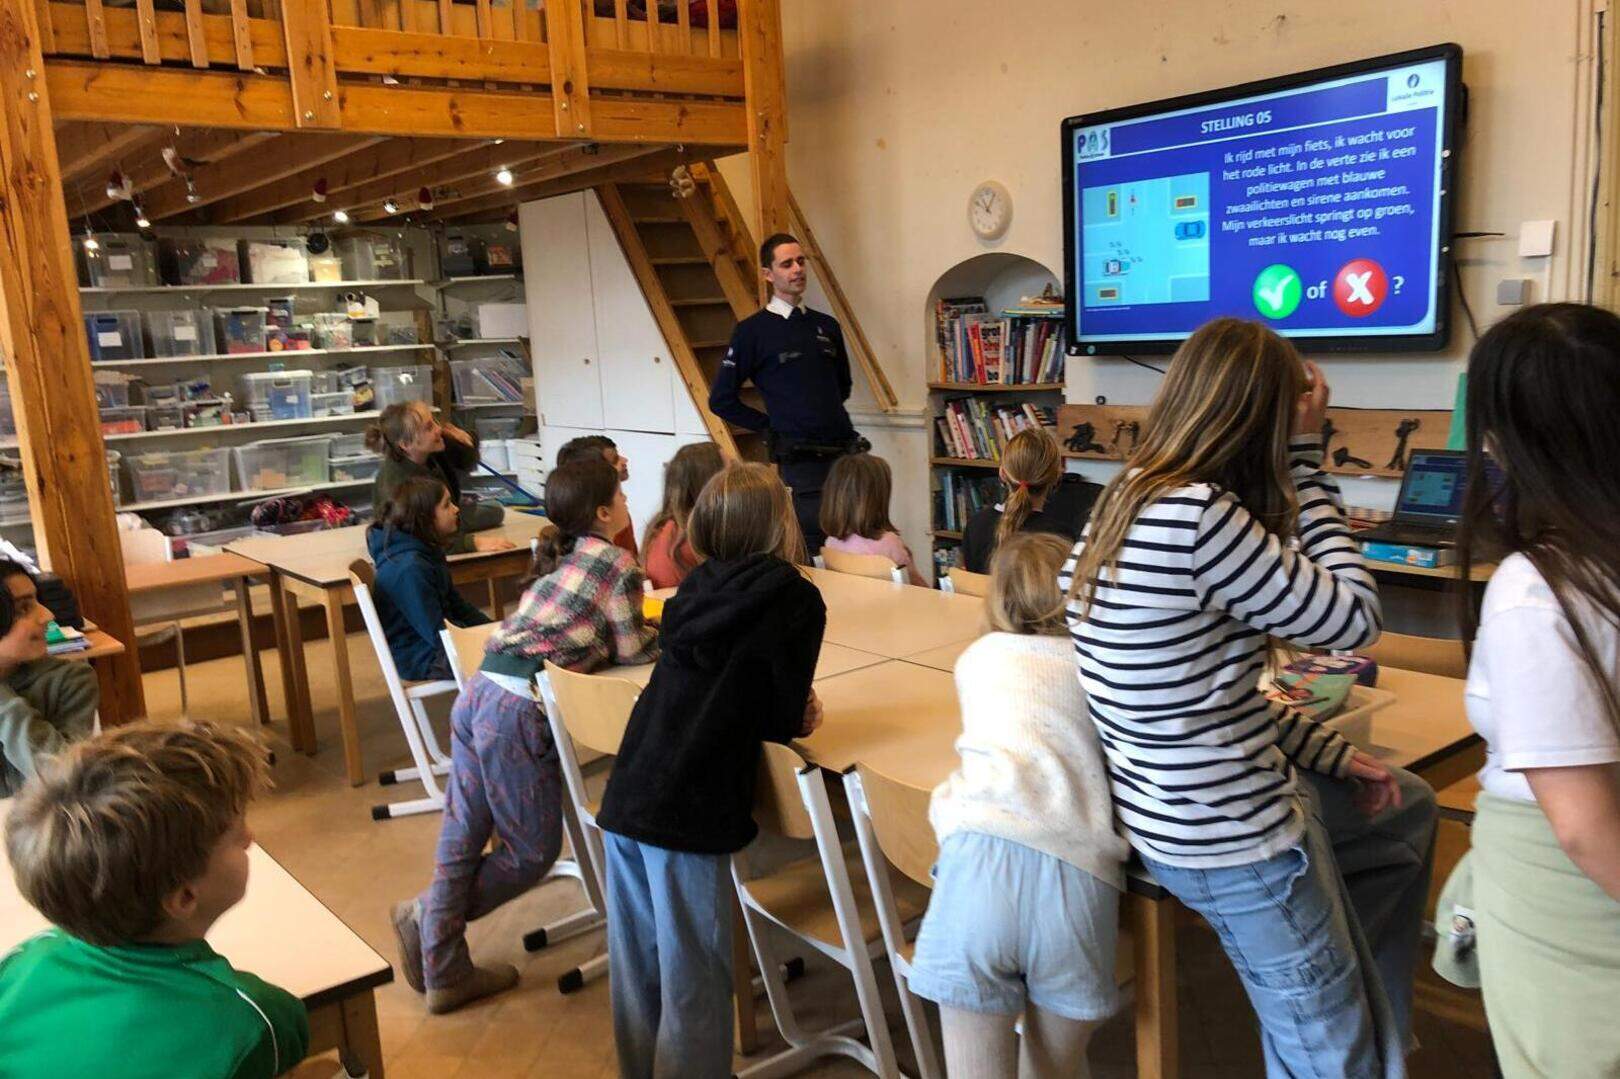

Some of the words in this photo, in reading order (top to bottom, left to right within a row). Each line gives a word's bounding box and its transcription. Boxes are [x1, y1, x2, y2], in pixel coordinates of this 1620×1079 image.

[1201, 113, 1254, 134] STELLING
[1256, 110, 1273, 125] 05
[1224, 151, 1235, 164] Ik
[1235, 149, 1253, 164] rijd
[1254, 147, 1276, 159] met
[1278, 143, 1303, 158] mijn
[1304, 140, 1332, 152] fiets,
[1334, 135, 1346, 148] ik
[1347, 130, 1385, 146] wacht
[1386, 126, 1417, 140] voor
[1222, 169, 1240, 181] het
[1241, 165, 1266, 179] rode
[1267, 162, 1294, 175] licht.
[1296, 160, 1308, 172] In
[1309, 157, 1325, 170] de
[1326, 153, 1358, 167] verte
[1359, 150, 1377, 163] zie
[1378, 147, 1391, 160] ik
[1391, 146, 1417, 159] een
[1246, 179, 1315, 197] politiewagen
[1316, 174, 1340, 187] met
[1341, 169, 1386, 184] blauwe
[1225, 198, 1289, 215] zwaailichten
[1290, 197, 1306, 208] en
[1306, 193, 1342, 206] sirene
[1343, 186, 1411, 202] aankomen.
[1222, 220, 1245, 233] Mijn
[1246, 212, 1314, 229] verkeerslicht
[1314, 209, 1355, 225] springt
[1356, 208, 1373, 220] op
[1374, 204, 1415, 220] groen,
[1248, 235, 1276, 247] maar
[1277, 232, 1288, 244] ik
[1288, 229, 1322, 243] wacht
[1324, 229, 1347, 242] nog
[1347, 226, 1380, 238] even.
[1306, 280, 1328, 300] of
[1392, 275, 1405, 295] ?
